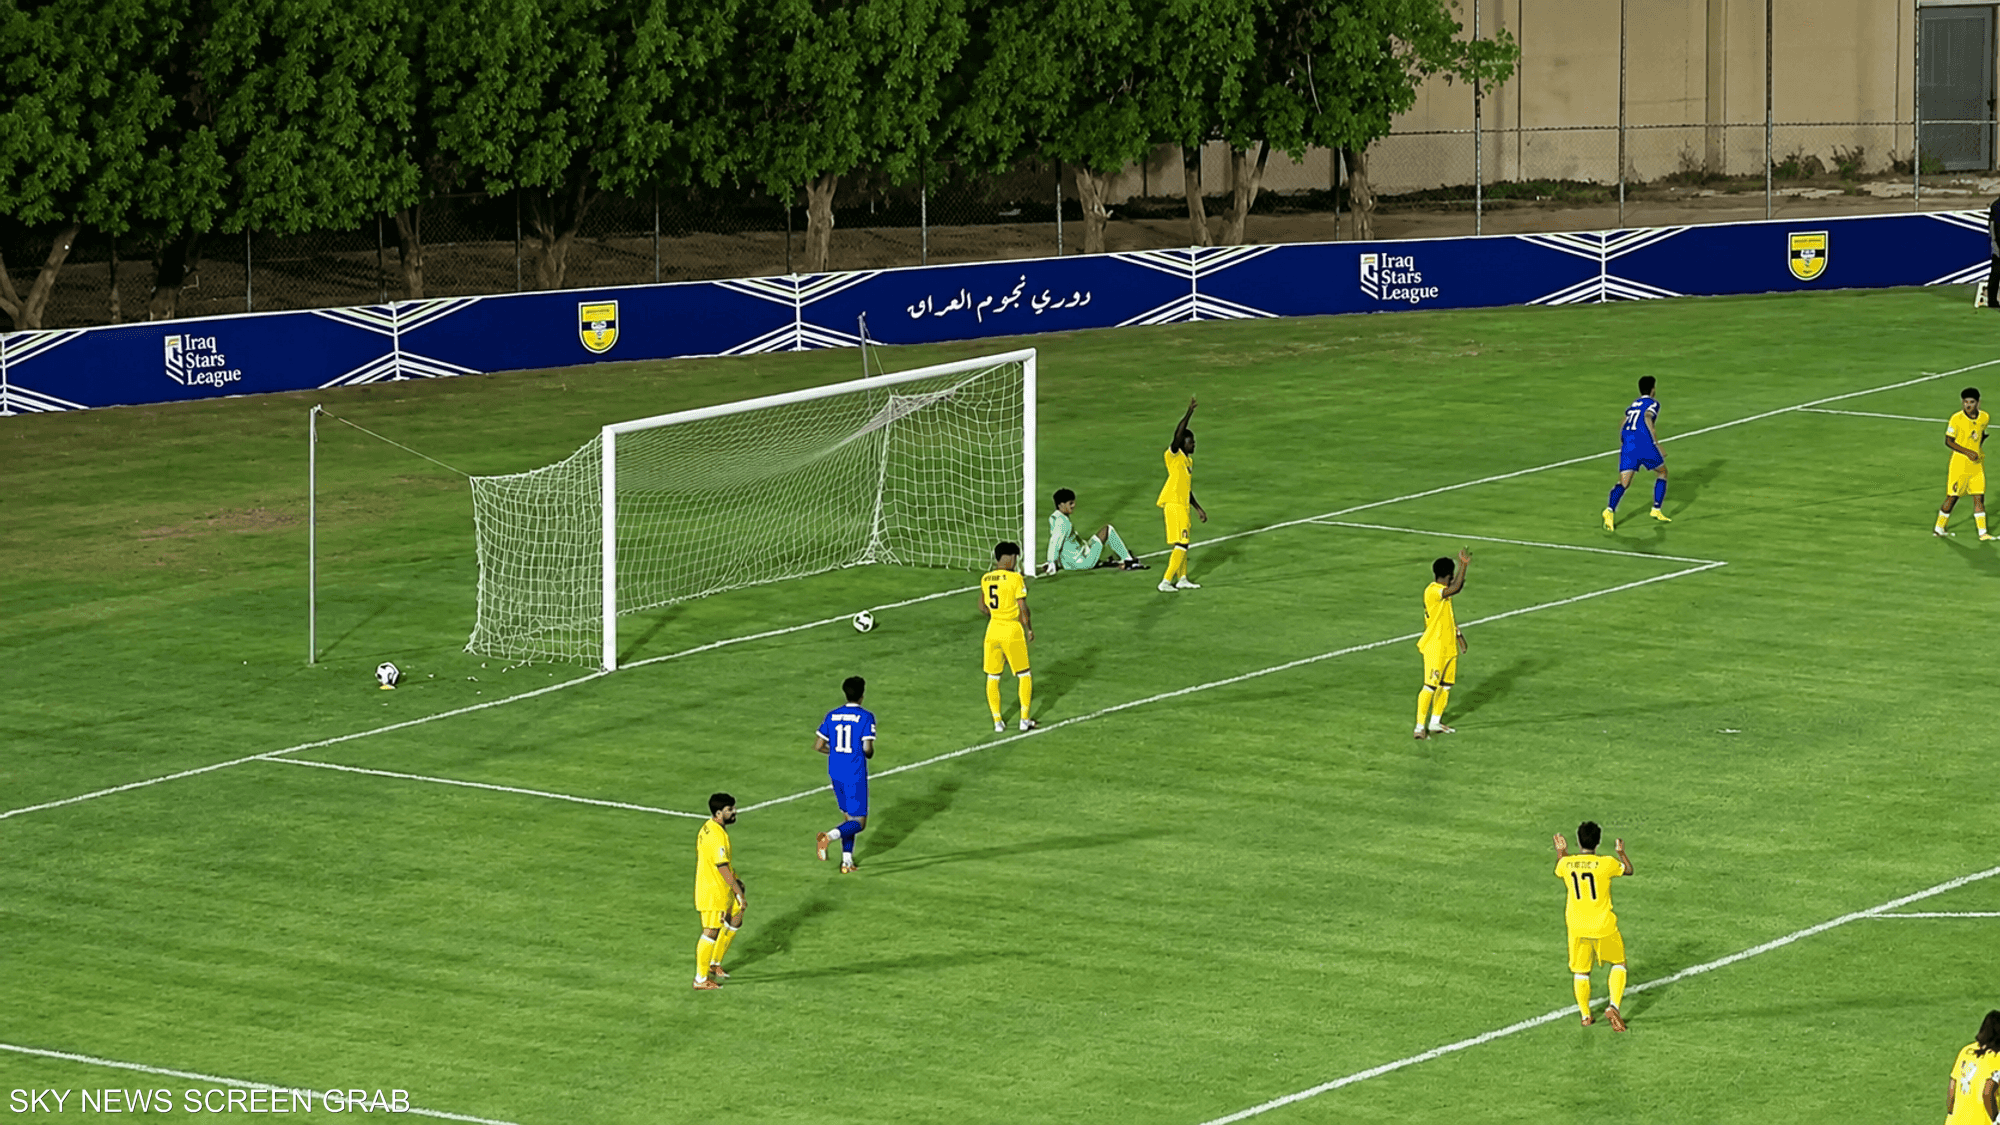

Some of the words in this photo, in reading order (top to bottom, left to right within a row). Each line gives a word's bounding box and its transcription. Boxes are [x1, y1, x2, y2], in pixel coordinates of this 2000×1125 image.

[1381, 252, 1415, 272] Iraq
[1381, 269, 1422, 285] Stars
[906, 288, 972, 319] العراق
[976, 274, 1027, 323] نجوم
[1031, 289, 1092, 315] دوري
[1381, 285, 1439, 304] League
[184, 333, 218, 354] Iraq
[185, 351, 225, 369] Stars
[186, 368, 242, 388] League
[988, 584, 999, 610] 5
[835, 723, 853, 754] 11
[1571, 871, 1597, 900] 17
